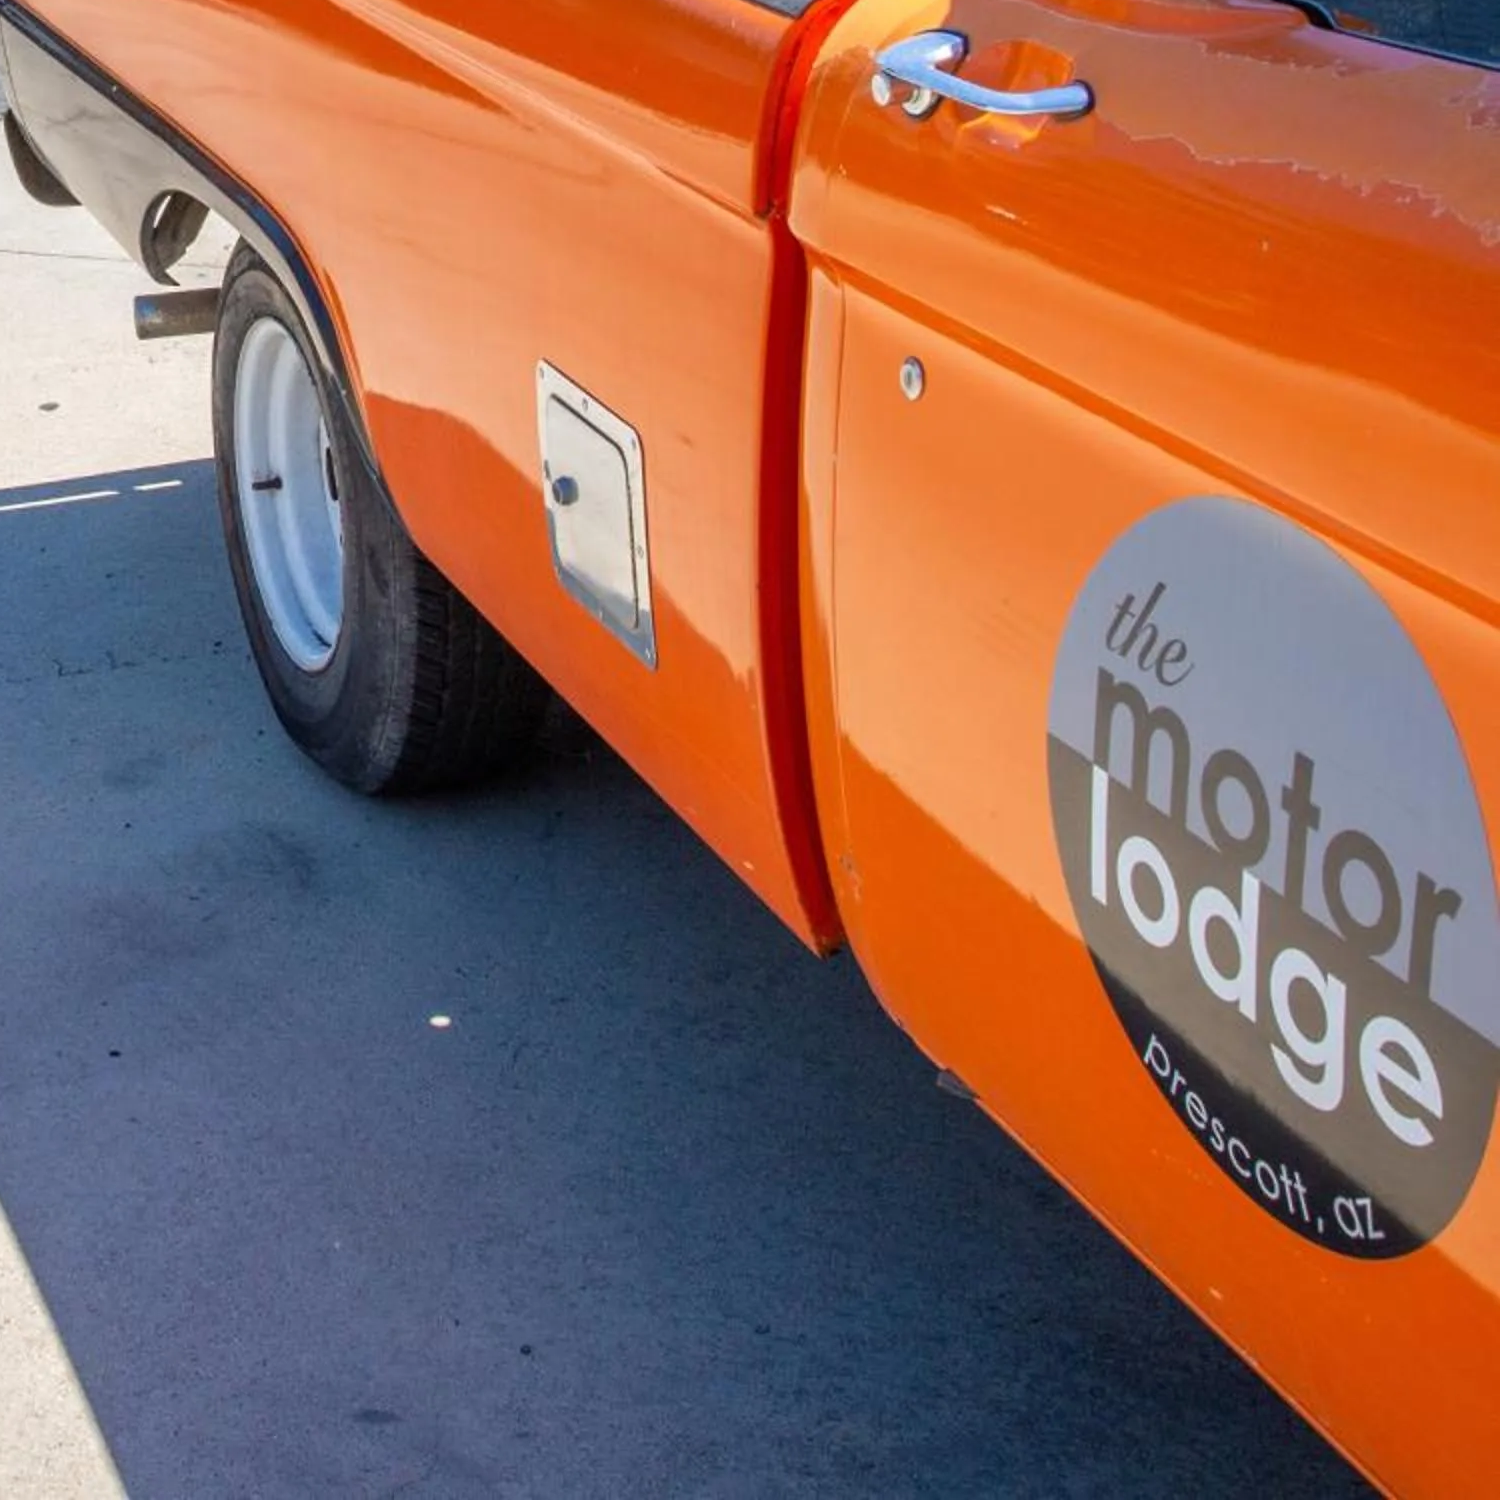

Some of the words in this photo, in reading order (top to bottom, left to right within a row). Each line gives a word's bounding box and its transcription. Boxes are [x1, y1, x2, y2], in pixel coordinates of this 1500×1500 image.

[1105, 581, 1196, 687] the
[1093, 665, 1463, 1002] motor
[1091, 763, 1444, 1147] lodge
[1334, 1196, 1386, 1239] az
